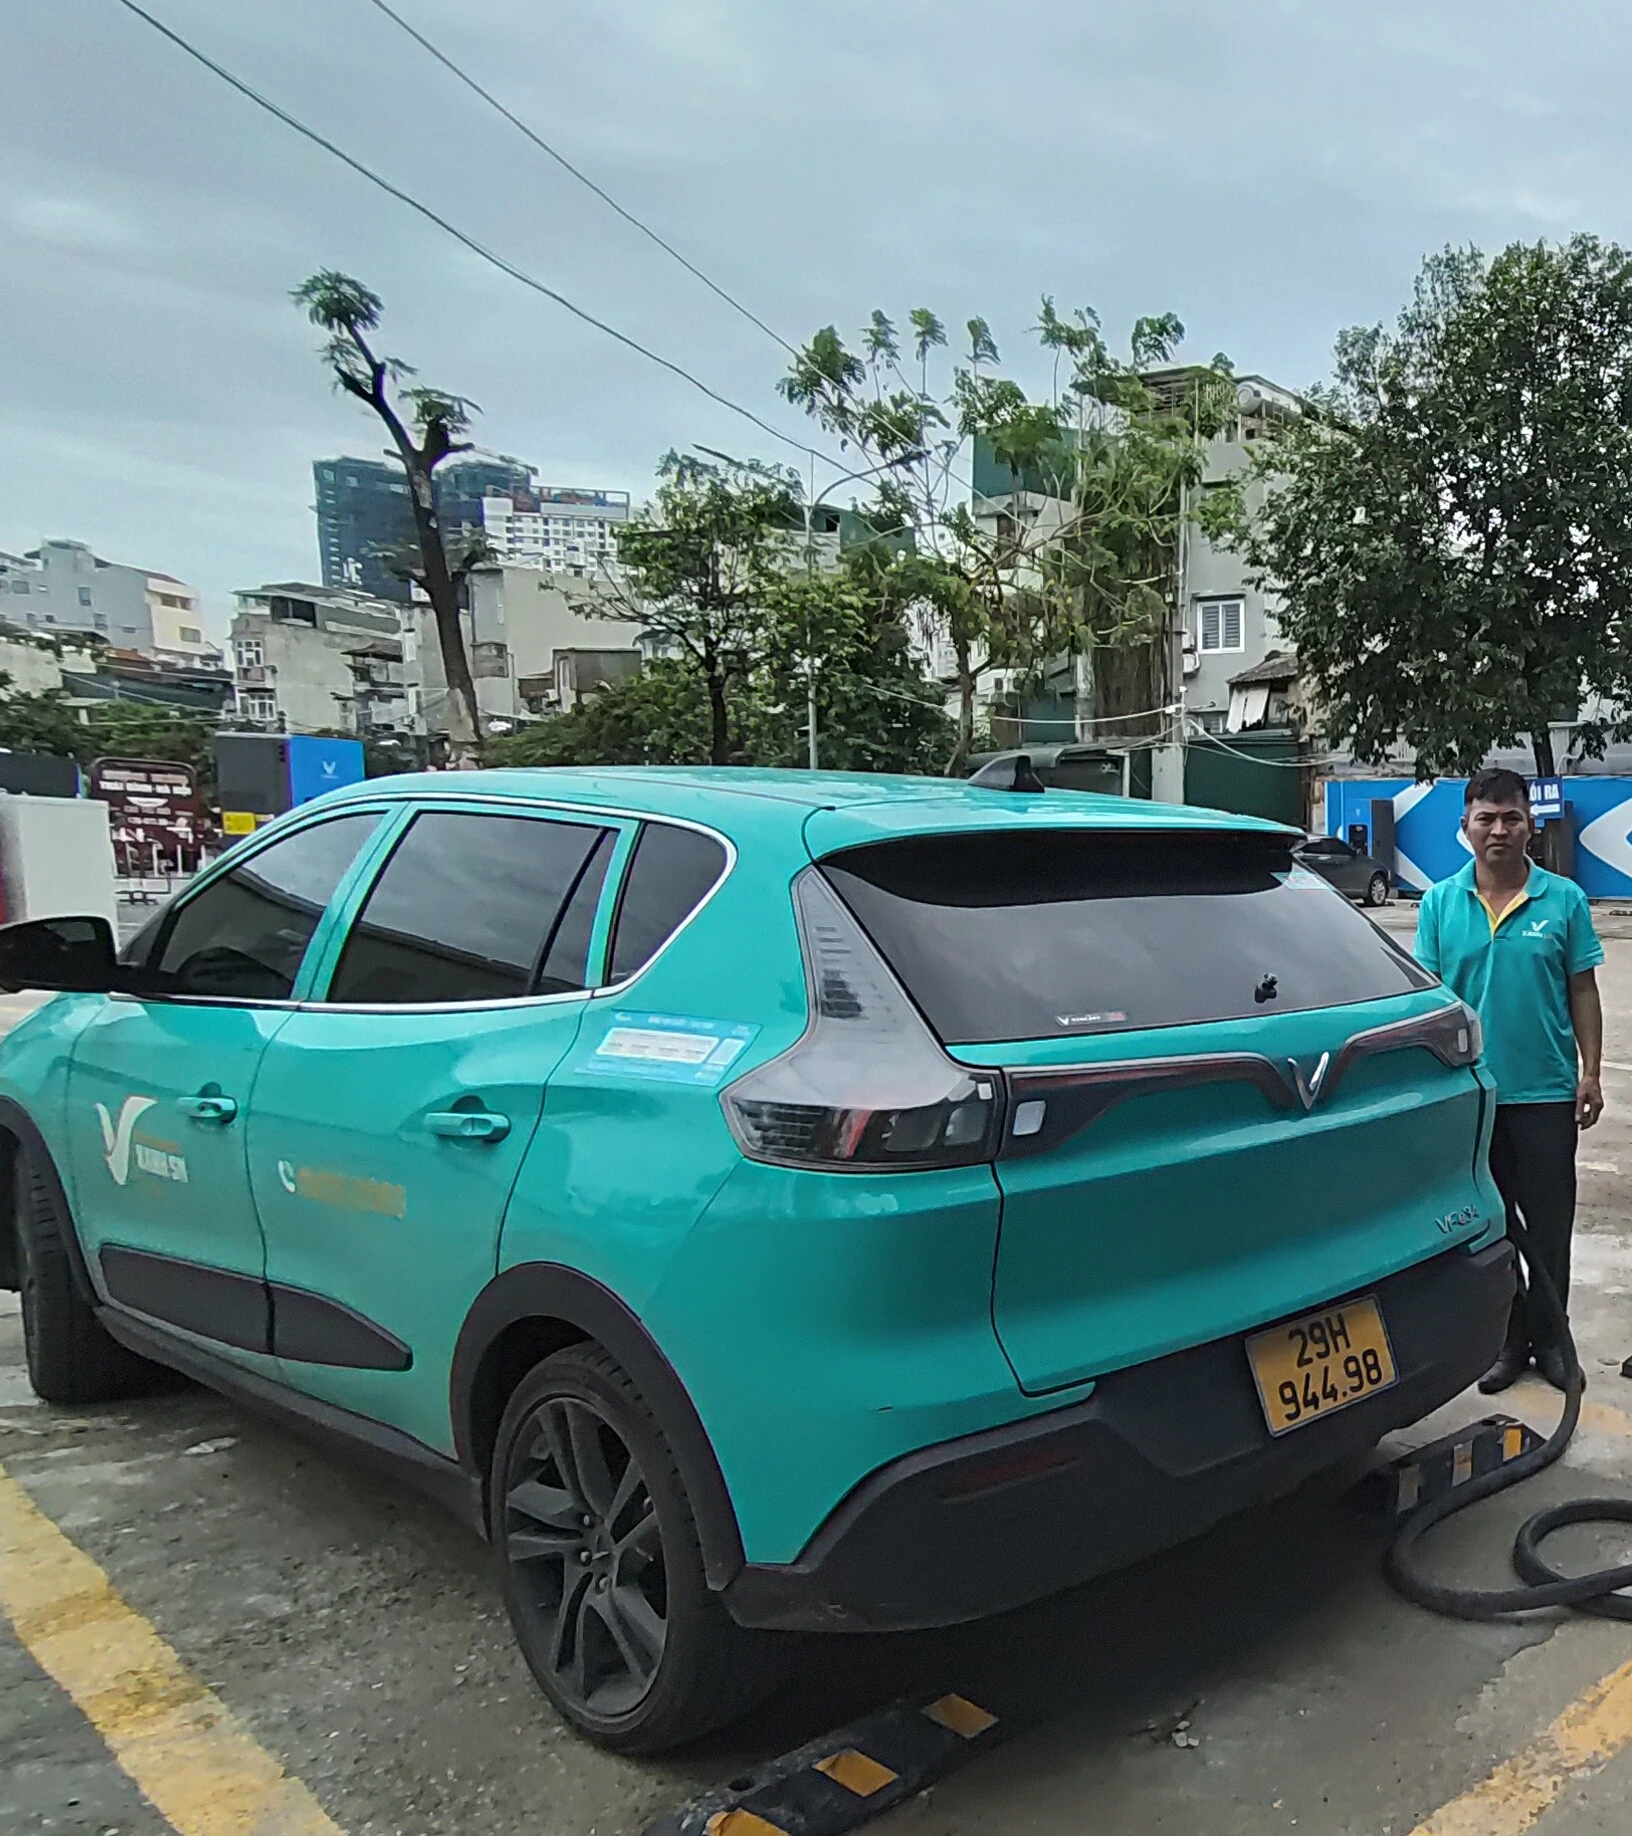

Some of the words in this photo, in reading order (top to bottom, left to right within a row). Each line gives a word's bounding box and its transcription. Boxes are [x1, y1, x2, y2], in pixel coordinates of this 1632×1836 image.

[1544, 783, 1560, 800] RA
[1288, 1313, 1351, 1368] 29H
[1278, 1348, 1383, 1421] 944.98
